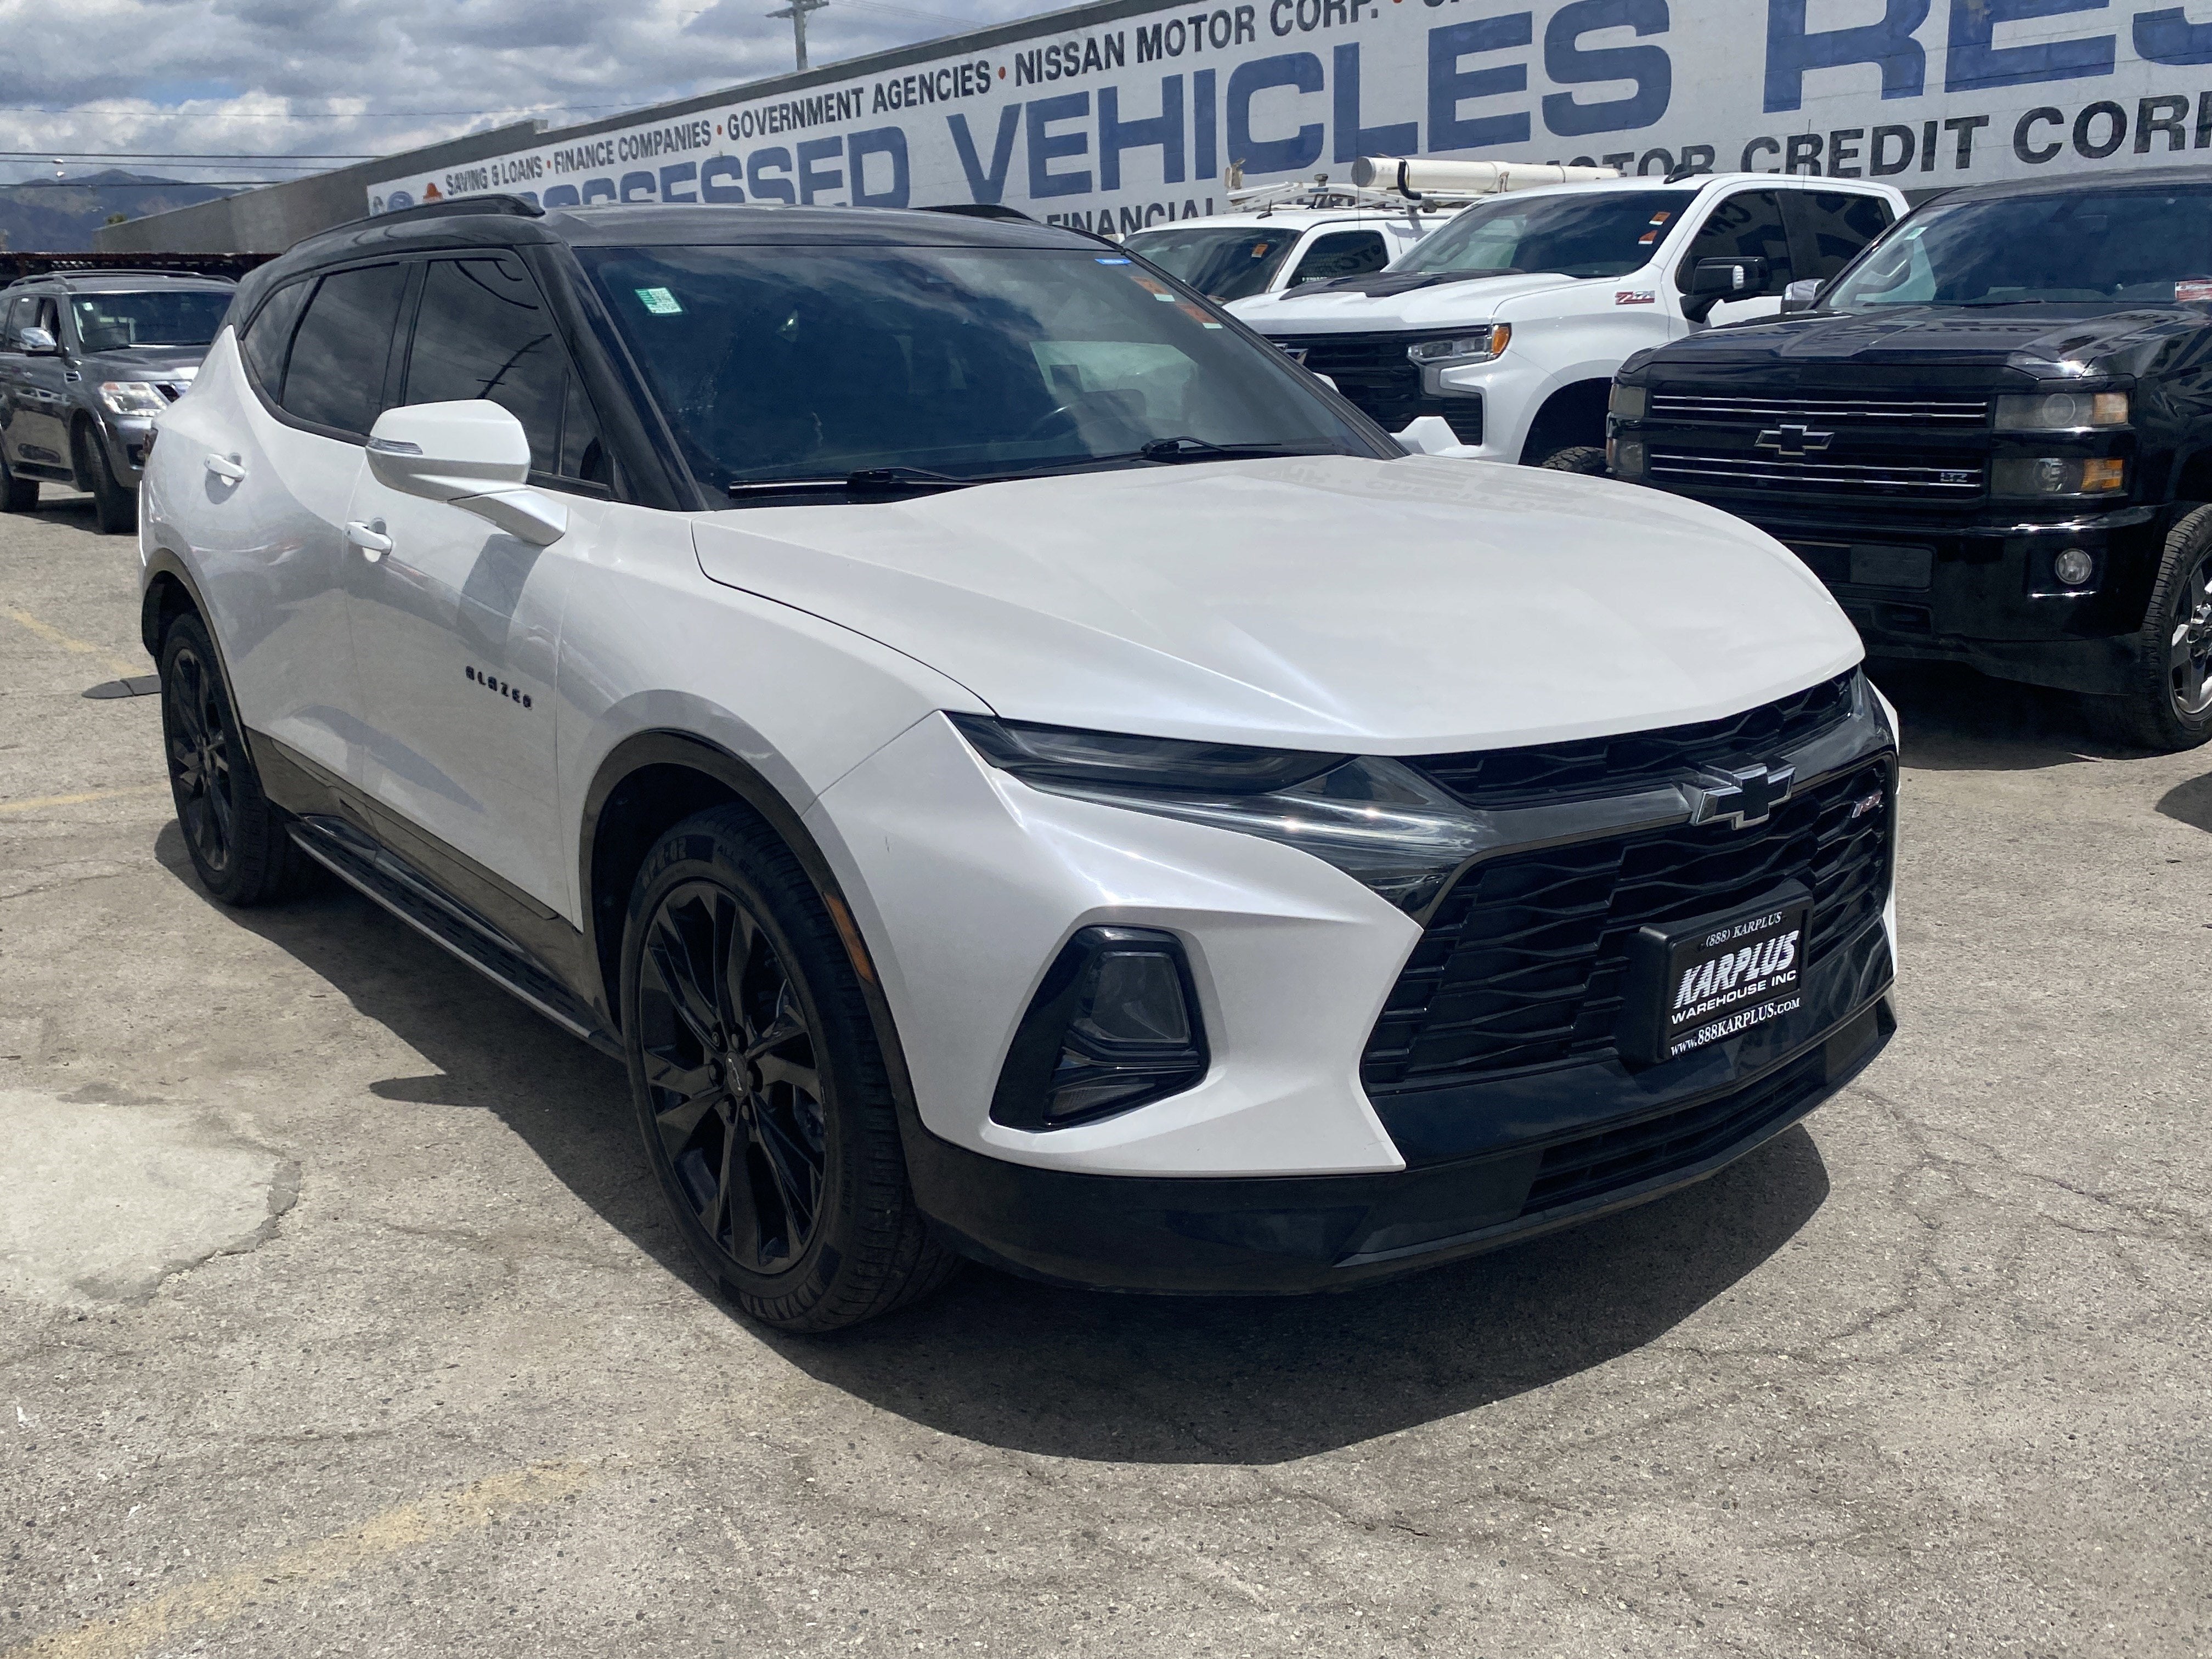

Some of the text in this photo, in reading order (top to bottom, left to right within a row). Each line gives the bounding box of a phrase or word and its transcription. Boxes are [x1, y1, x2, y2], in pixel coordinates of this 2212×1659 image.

[445, 167, 488, 196] SAVING
[501, 155, 543, 184] LOANS
[554, 140, 614, 174] FINANCE
[618, 120, 712, 160] COMPANIES
[727, 87, 864, 140] GOVERNMENT
[872, 60, 991, 114] AGENCIES
[1015, 32, 1125, 87] NISSAN
[1137, 4, 1256, 64] MOTOR
[1270, 0, 1379, 37] CORP.
[946, 0, 1672, 205] VEHICLES
[1525, 144, 1716, 176] TOR
[1740, 114, 1990, 178] CREDIT
[1940, 472, 1968, 483] LTZ
[465, 665, 533, 709] BLAZER
[1705, 911, 1782, 947] (888) KARPLUS
[1671, 970, 1797, 1025] WAREHOUSE INC
[1673, 930, 1800, 1009] KARPLUS
